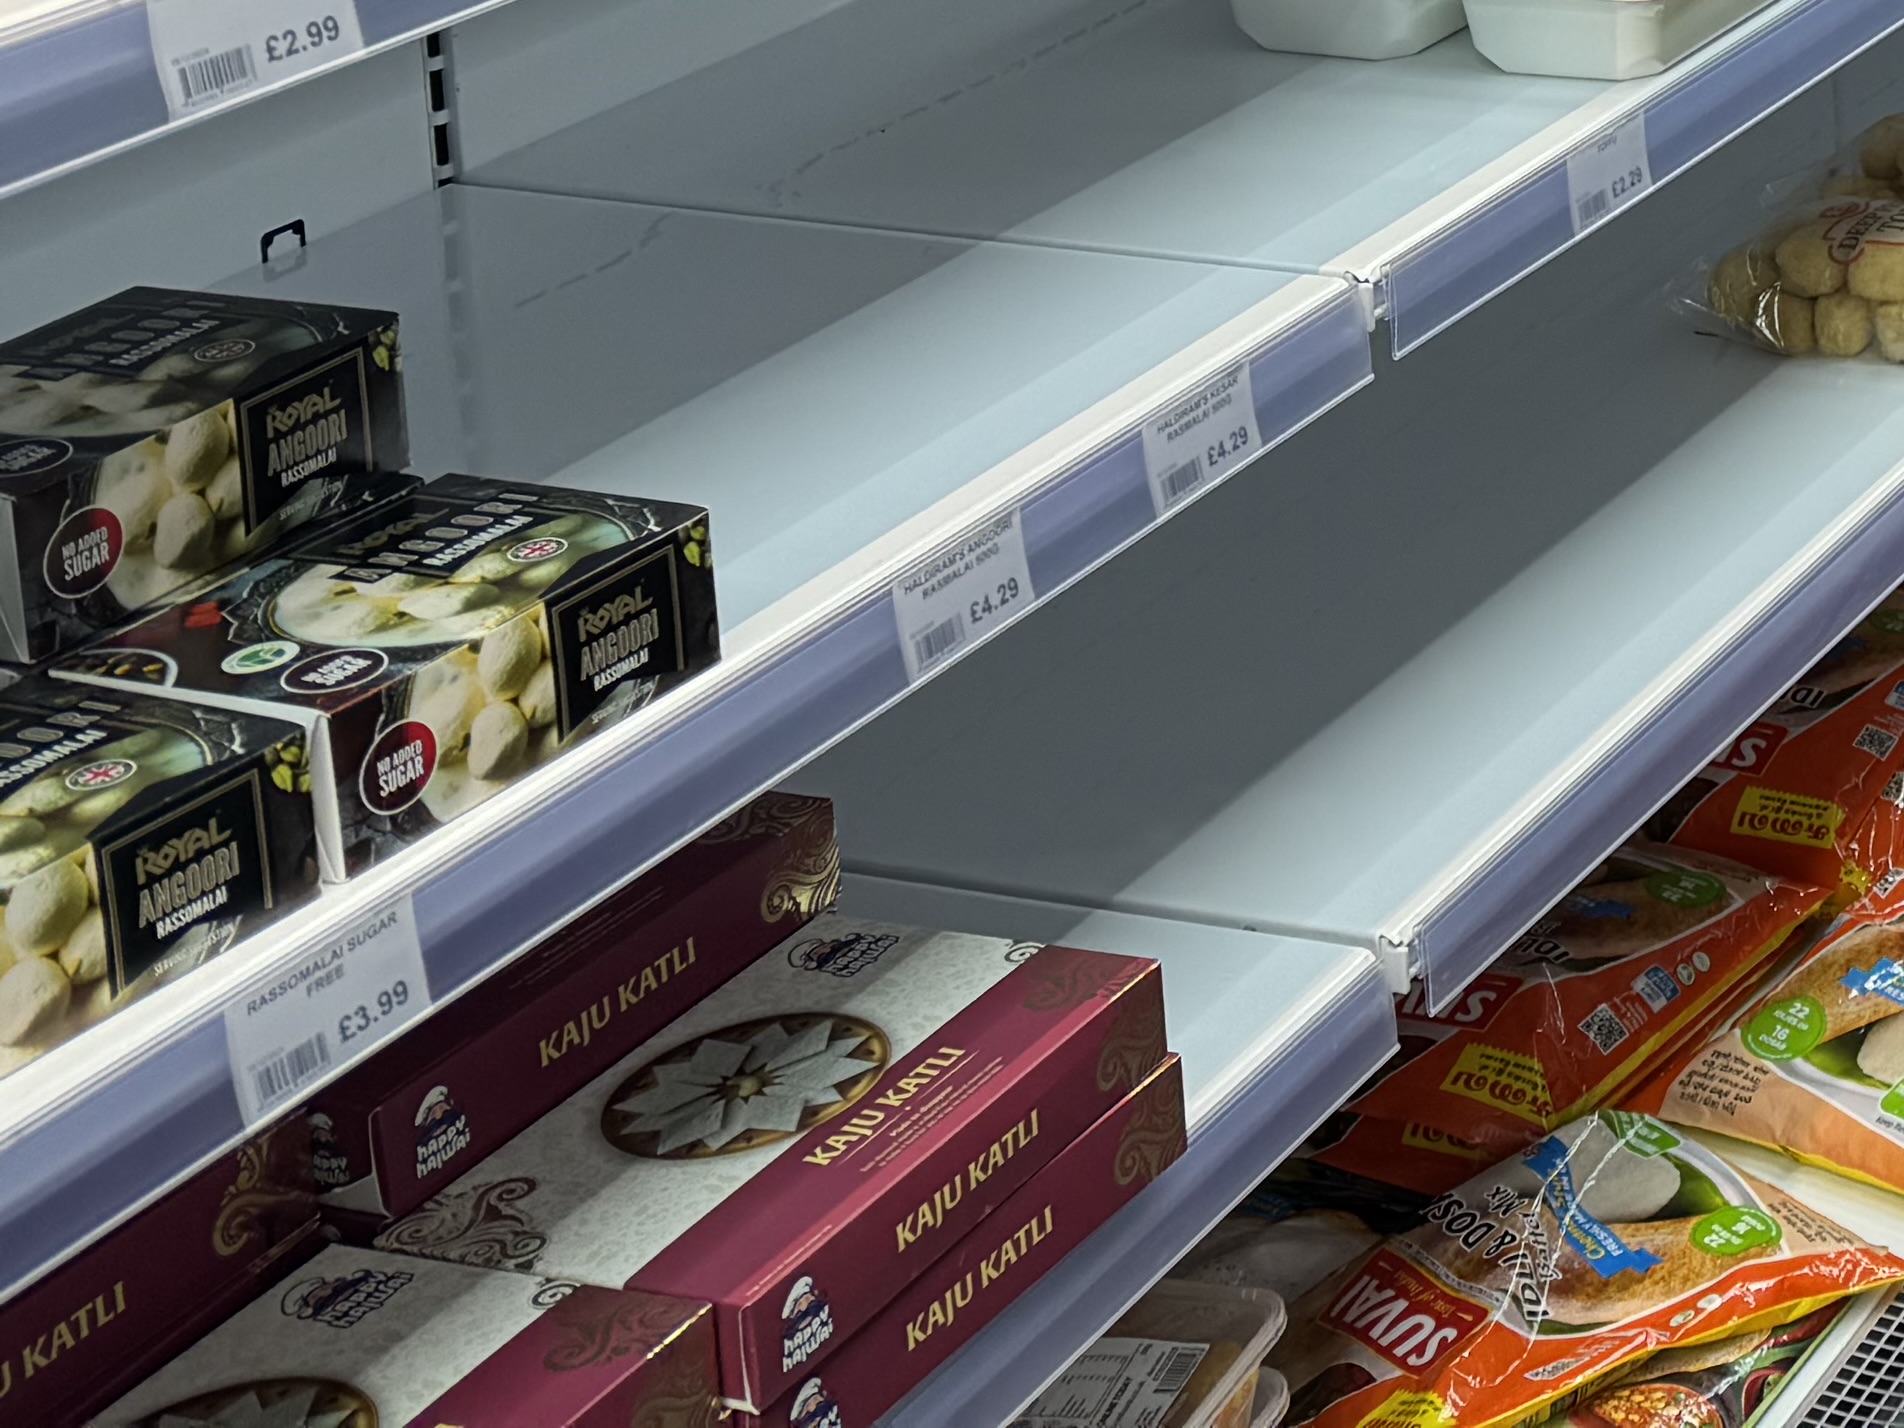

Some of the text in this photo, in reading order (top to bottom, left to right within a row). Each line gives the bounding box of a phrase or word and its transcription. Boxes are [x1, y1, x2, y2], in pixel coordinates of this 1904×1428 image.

[265, 15, 340, 64] £2.99
[1611, 166, 1643, 199] £2.29
[266, 387, 342, 439] ROYAL
[267, 408, 348, 477] ANGOORI
[281, 446, 337, 487] RASSOMALAI
[1207, 426, 1249, 468] £4.29
[61, 525, 108, 559] NO ADDED
[63, 543, 110, 581] SUGAR
[577, 584, 653, 642] ROYAL
[969, 577, 1021, 624] £4.29
[580, 608, 659, 681] ANGOORI
[594, 647, 649, 692] RASSOMALAI
[378, 757, 426, 797] SUGAR
[393, 739, 424, 768] ADDED
[135, 817, 233, 885] ROYAL
[139, 840, 241, 929] ANGOORI
[156, 886, 229, 940] RASSOMALAI
[246, 911, 398, 1017] RASSOMALAI SUGAR
[305, 964, 345, 999] FREE
[336, 979, 411, 1044] £3.99
[538, 936, 697, 1069] KAJU KATLI
[810, 1044, 966, 1168] KAJU KATLI
[895, 1109, 1040, 1254] KAJU KATLI
[905, 1206, 1054, 1355] KAJU KATLI
[22, 1281, 127, 1381] KATLI
[1330, 1269, 1460, 1372] SUVAI
